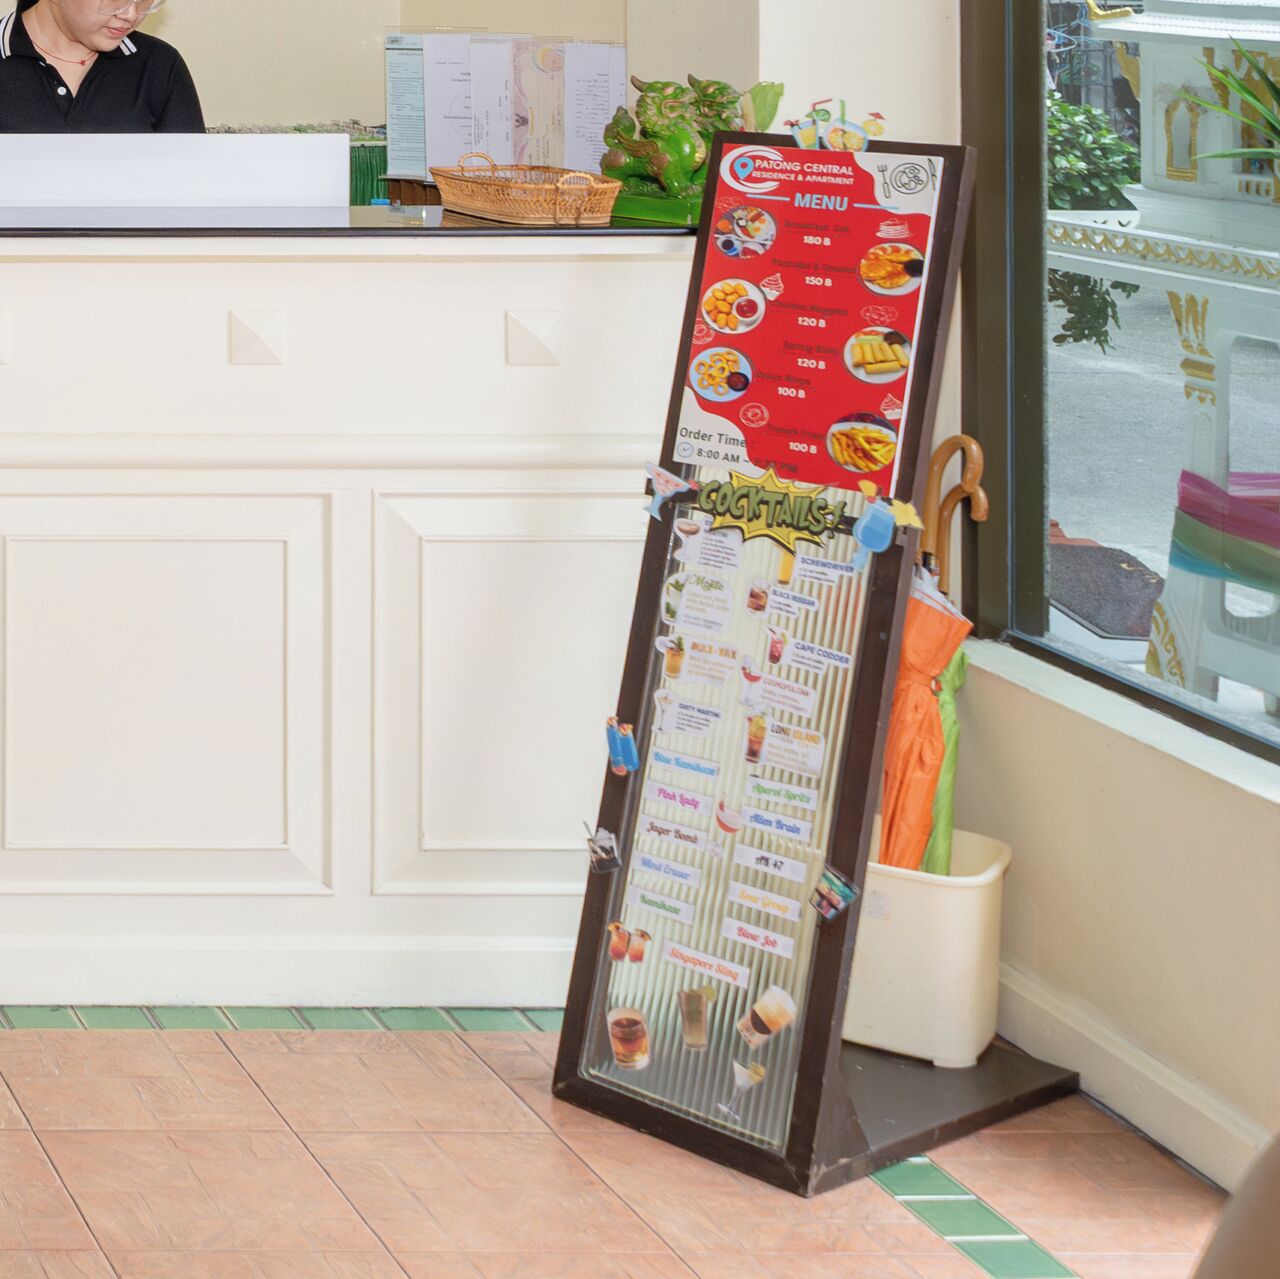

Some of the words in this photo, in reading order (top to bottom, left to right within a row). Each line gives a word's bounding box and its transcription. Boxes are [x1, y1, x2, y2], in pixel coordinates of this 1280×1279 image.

[754, 160, 801, 172] PATONG
[803, 163, 854, 176] CENTRAL
[752, 171, 795, 181] RESIDENCE
[806, 175, 854, 186] APARTMENT
[794, 192, 849, 211] MENU
[805, 276, 824, 286] 150
[798, 316, 817, 327] 120
[797, 358, 817, 368] 120
[777, 387, 797, 397] 100
[680, 427, 712, 442] Order
[717, 433, 747, 448] Time
[789, 442, 808, 452] 100
[696, 448, 720, 460] 8:00
[722, 452, 740, 464] AM
[800, 557, 854, 574] SCREWDRIVER
[794, 642, 816, 654] CAPE
[817, 648, 850, 665] CODDER
[678, 703, 696, 712] DIRTY
[697, 707, 721, 719] MARTINI
[770, 723, 792, 737] LONG
[657, 787, 677, 802] Pink
[679, 793, 700, 810] Lady
[761, 935, 779, 949] Job
[669, 947, 713, 970] Singapore
[715, 964, 740, 982] Sling
